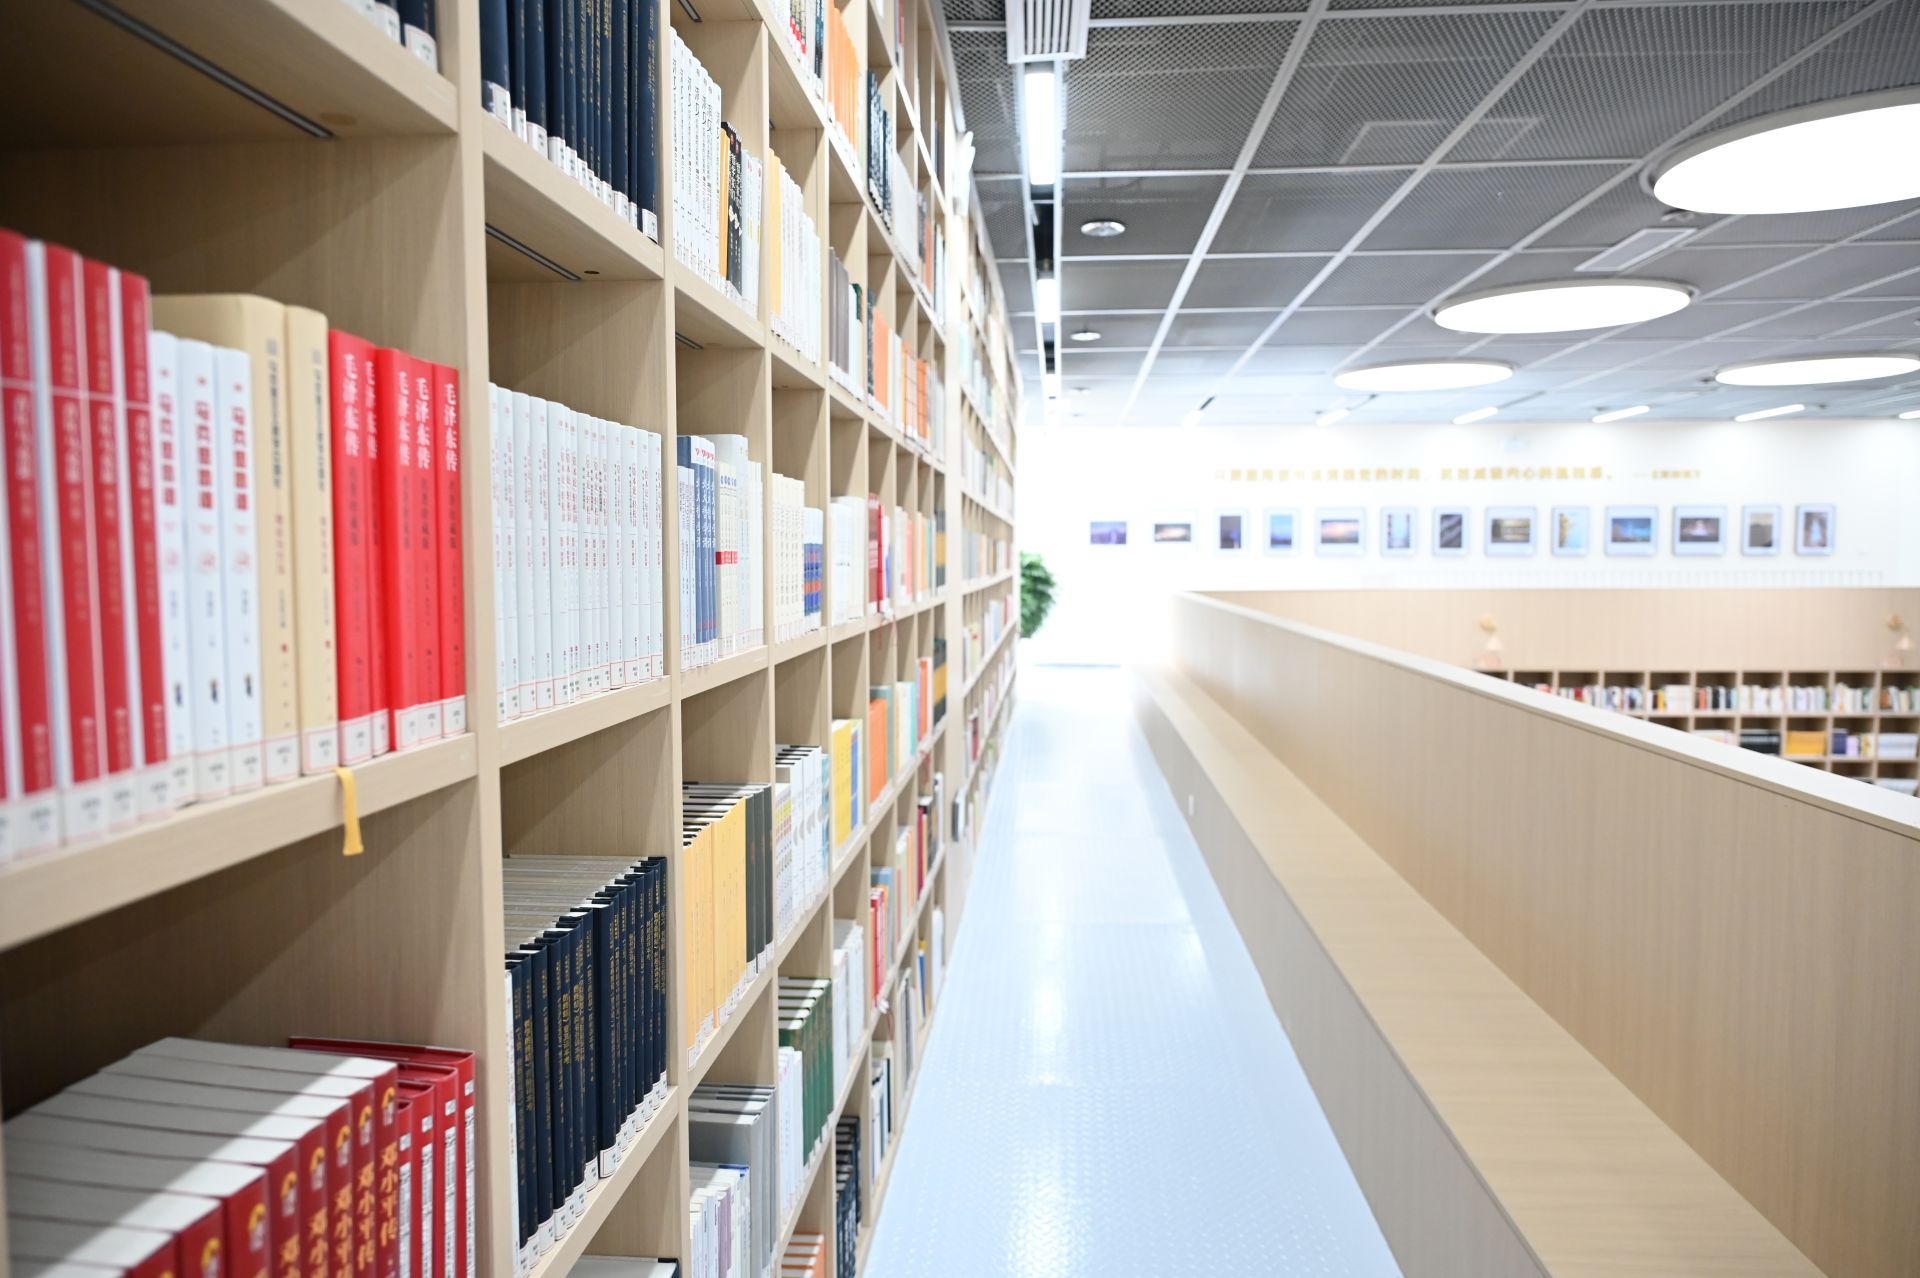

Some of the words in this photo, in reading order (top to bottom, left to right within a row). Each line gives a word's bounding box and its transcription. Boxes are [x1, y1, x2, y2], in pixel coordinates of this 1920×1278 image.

[343, 353, 360, 457] 毛泽东传
[397, 371, 411, 467] 毛泽东传
[415, 377, 430, 470] 毛泽东传
[444, 383, 458, 472] 毛泽东传
[357, 1161, 375, 1271] 邓小平传
[379, 1142, 397, 1248] 邓小平传
